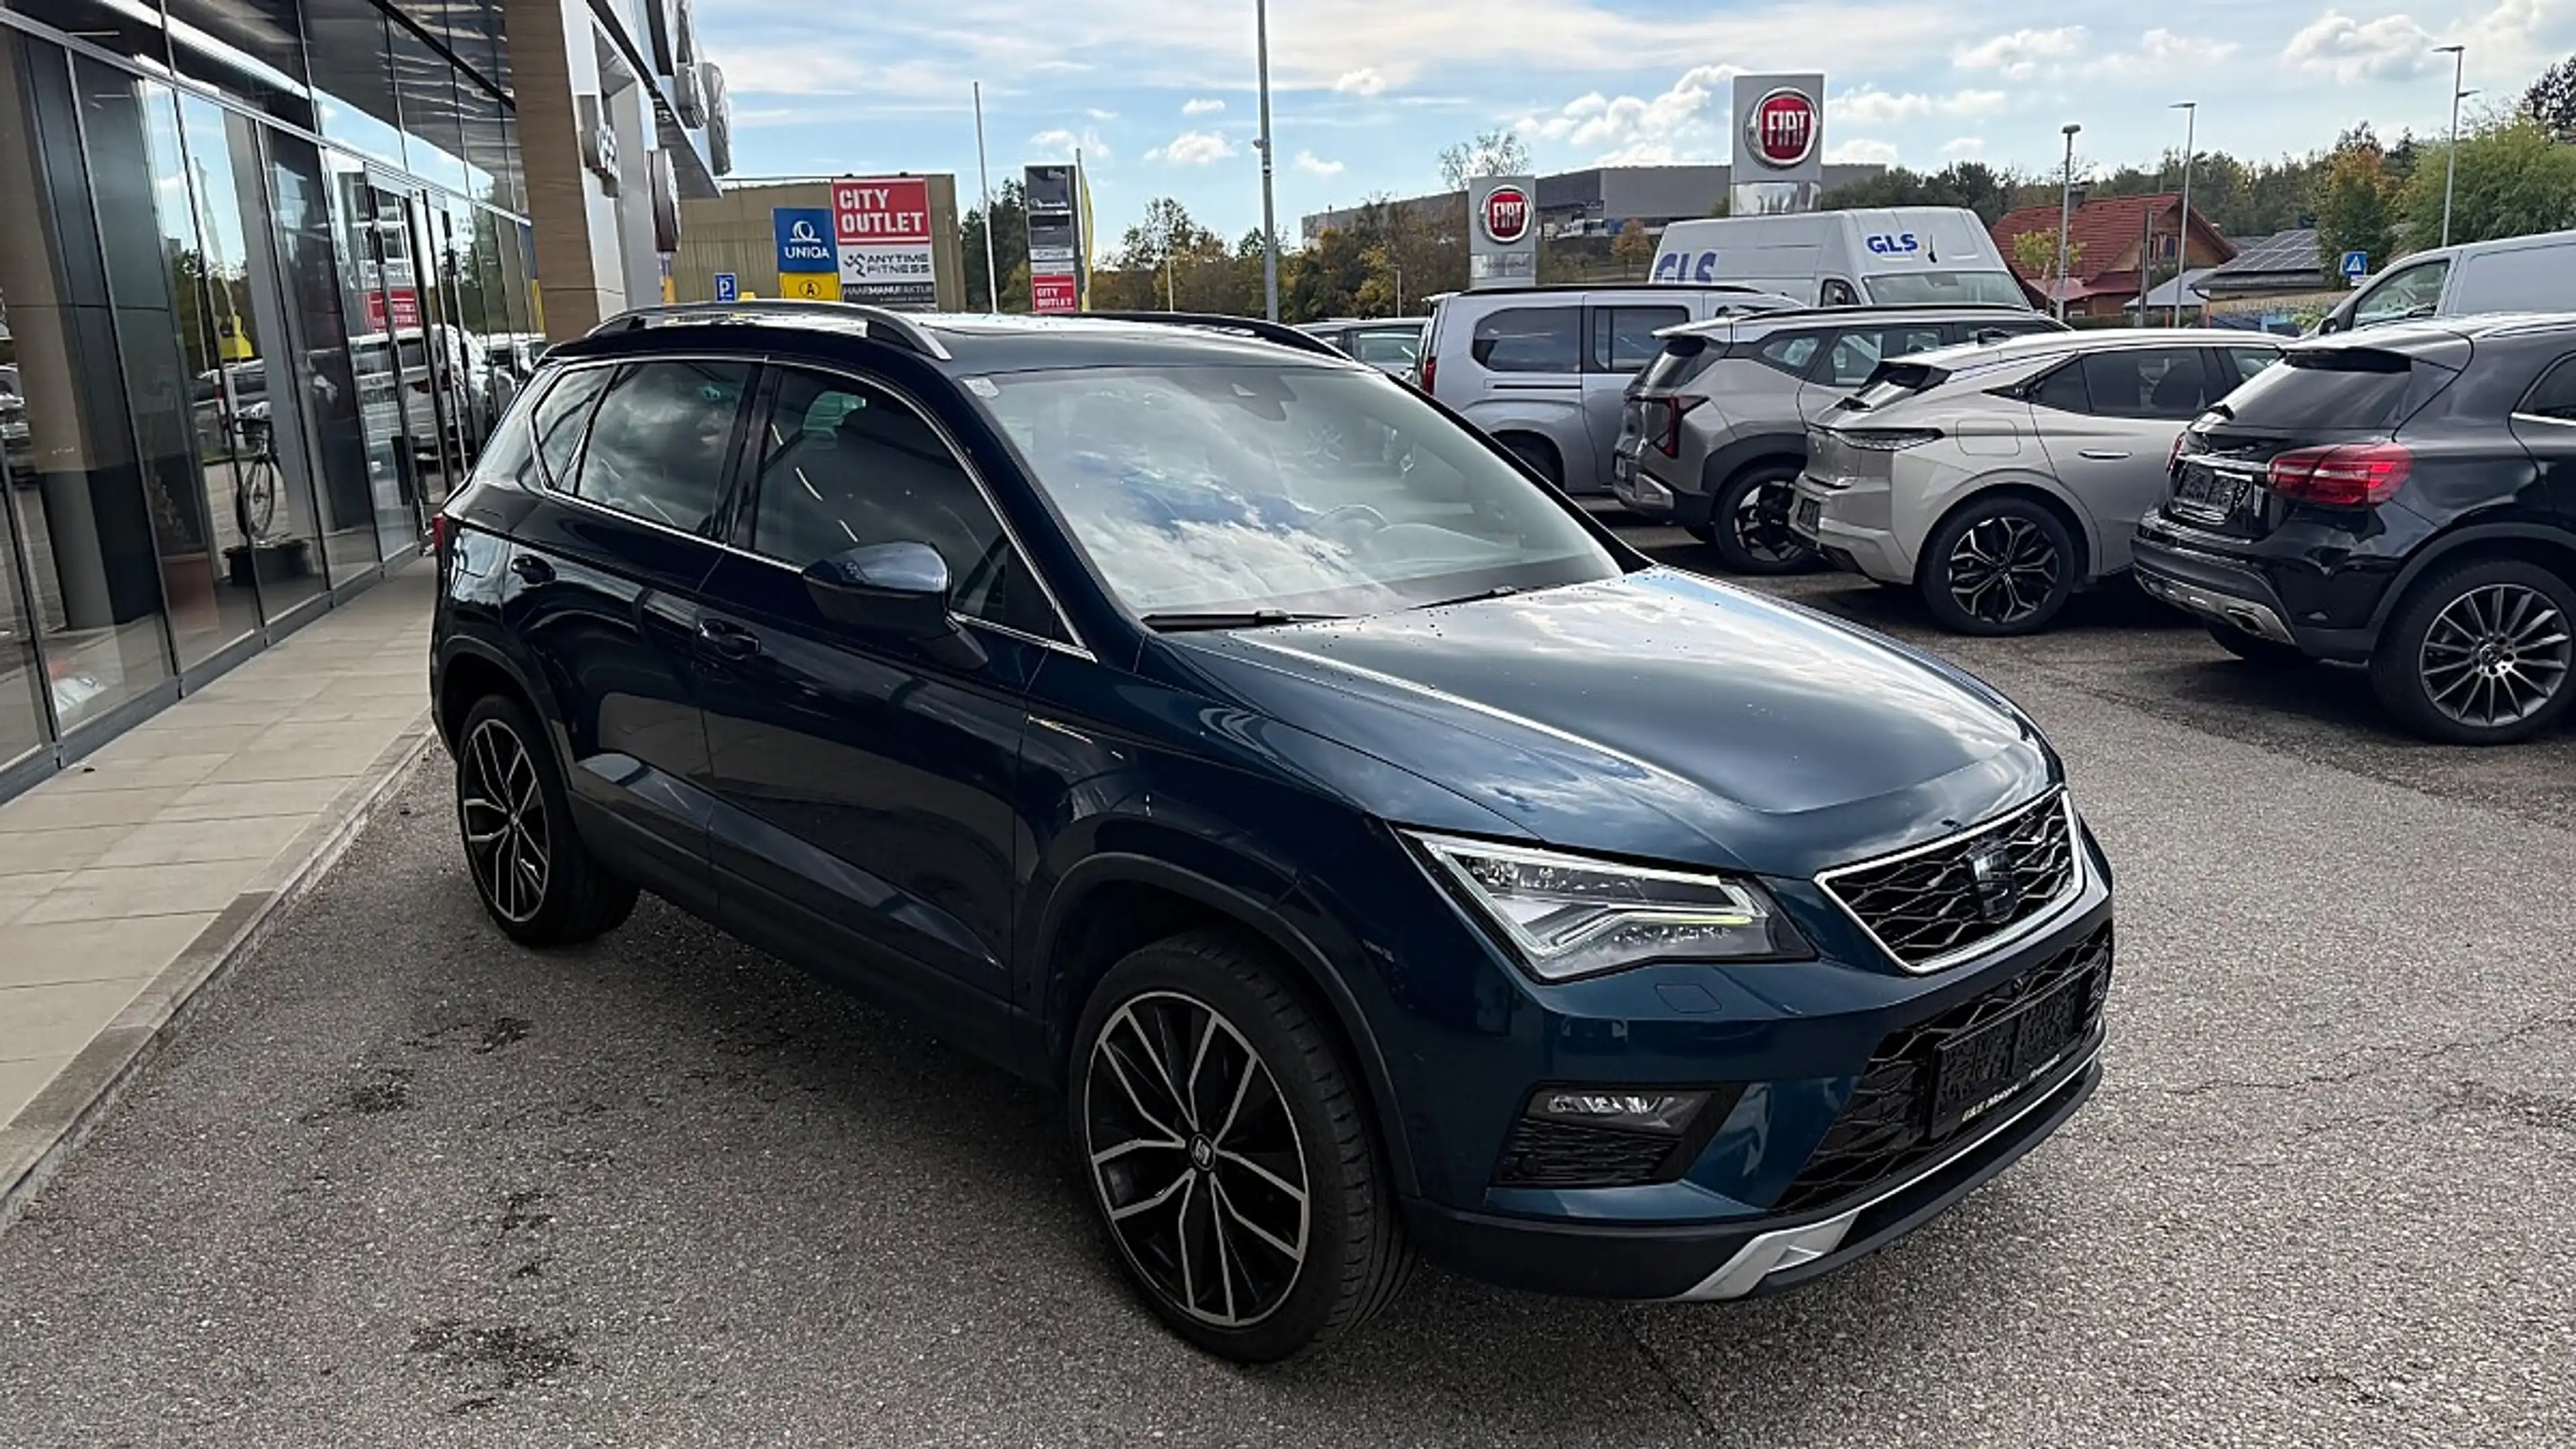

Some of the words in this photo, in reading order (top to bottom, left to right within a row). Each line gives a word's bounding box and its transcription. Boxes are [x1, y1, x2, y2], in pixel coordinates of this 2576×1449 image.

[1768, 111, 1808, 147] FIAT
[839, 189, 890, 210] CITY
[841, 212, 924, 233] OUTLET
[1493, 201, 1523, 229] FIAT
[784, 246, 830, 259] UNIQA
[1866, 233, 1919, 254] GLS
[867, 254, 928, 263] ANYTIME
[867, 264, 930, 274] FITNESS
